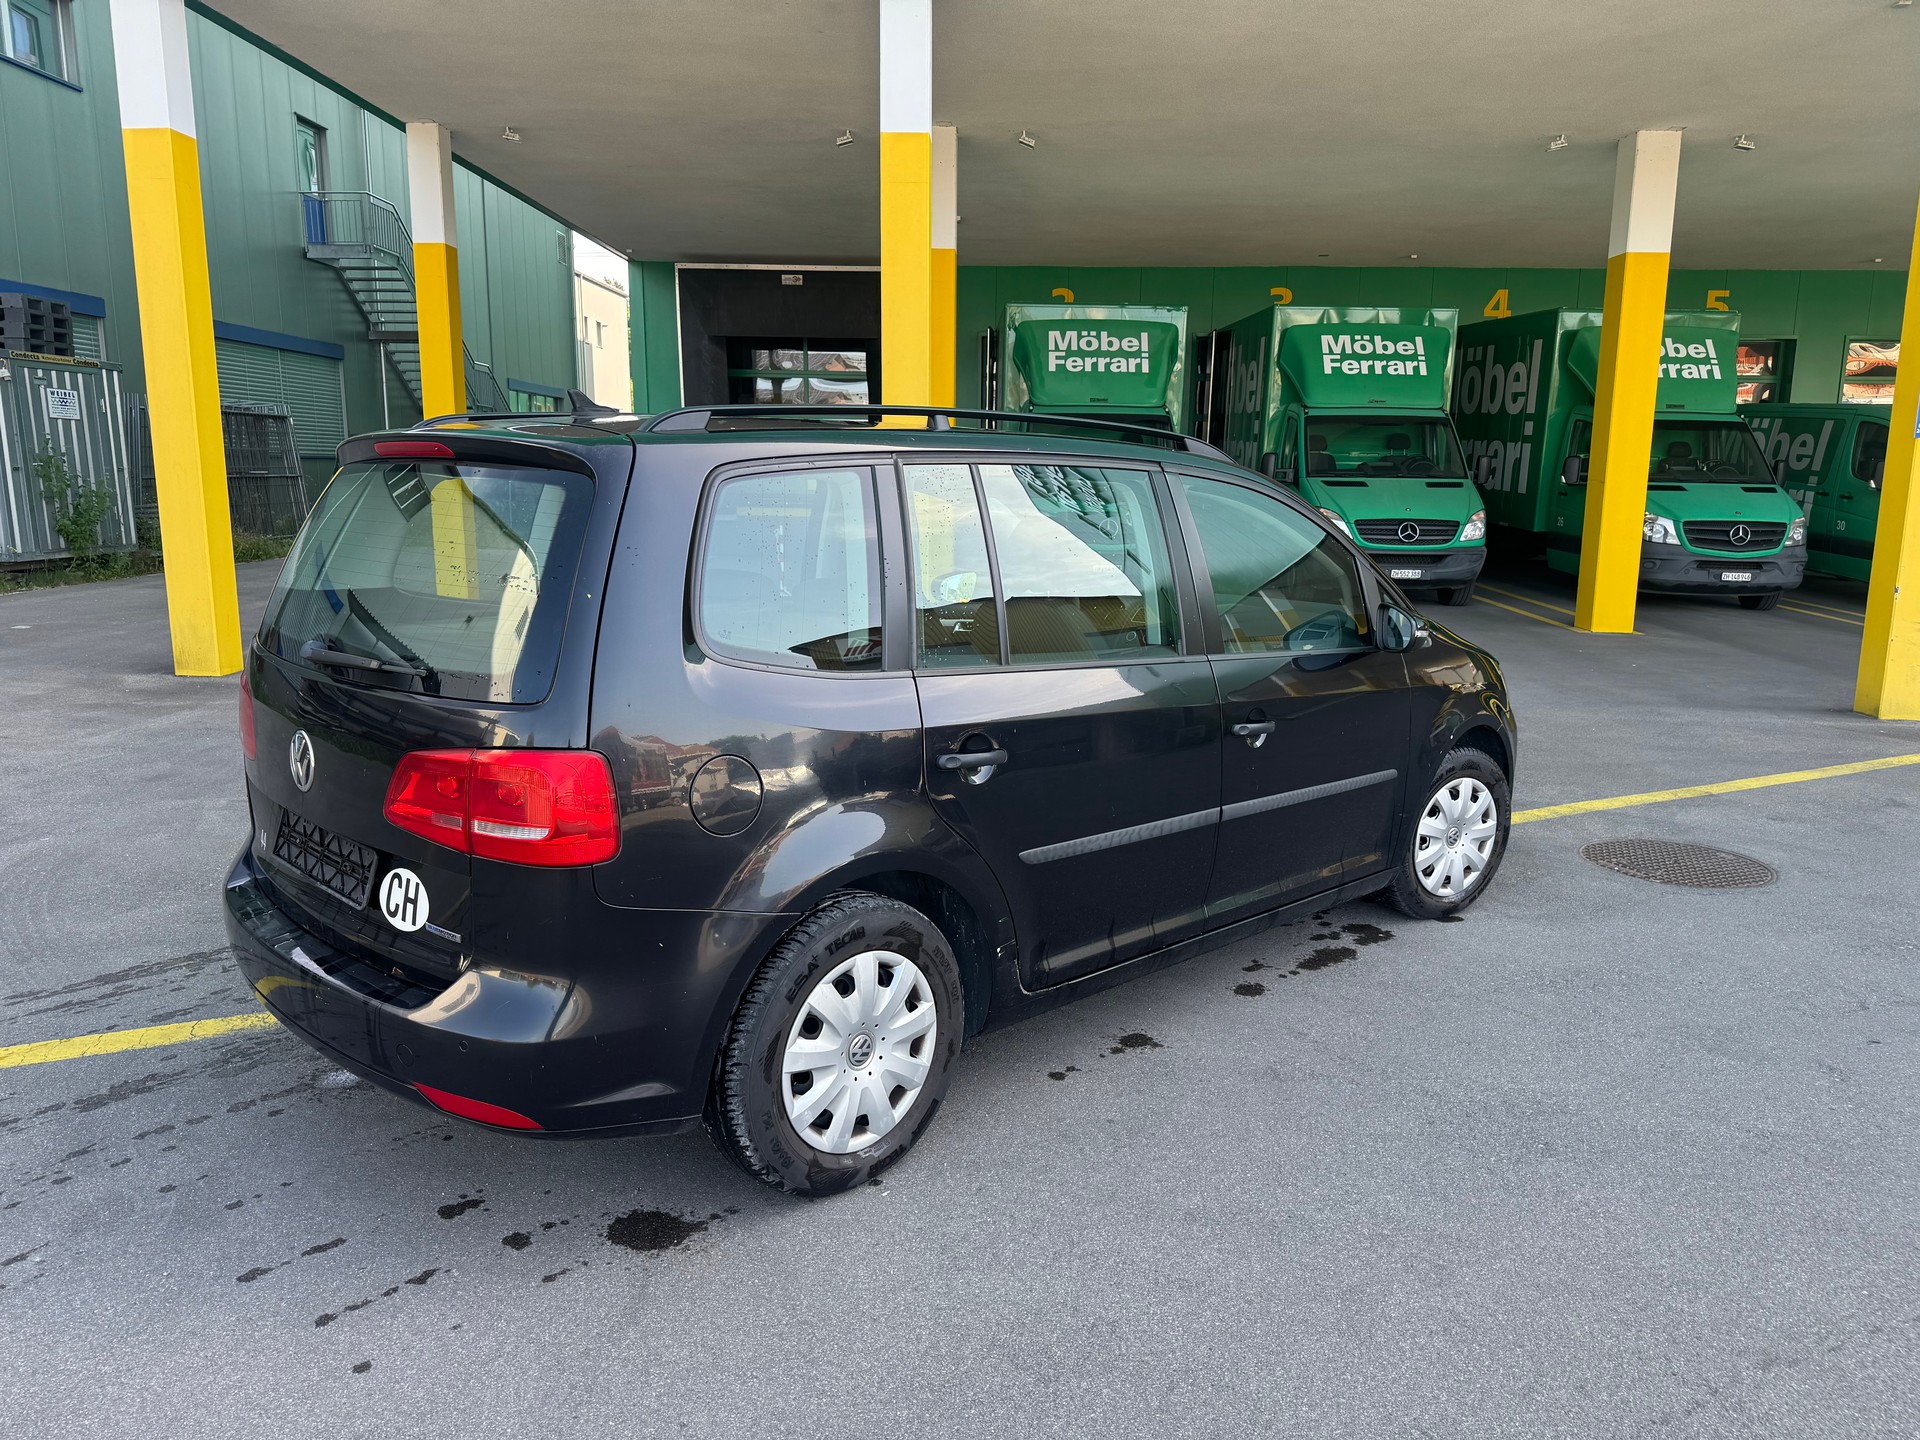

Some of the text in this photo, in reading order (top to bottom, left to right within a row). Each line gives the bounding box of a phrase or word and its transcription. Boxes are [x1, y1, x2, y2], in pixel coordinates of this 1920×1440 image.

[1483, 289, 1512, 319] 4
[1048, 330, 1148, 352] Möbel
[1320, 334, 1425, 355] Möbel
[1660, 337, 1717, 359] bel
[11, 351, 40, 360] Condecta
[72, 358, 99, 368] Condecta
[1048, 351, 1149, 373] Ferrari
[1322, 354, 1428, 376] Ferrari
[1658, 360, 1722, 380] rrari
[1455, 339, 1543, 414] öbel
[49, 389, 76, 398] WEIBEL
[1461, 421, 1534, 494] rrari
[1836, 520, 1846, 531] 30
[385, 871, 420, 927] CH
[824, 926, 866, 957] TECAR
